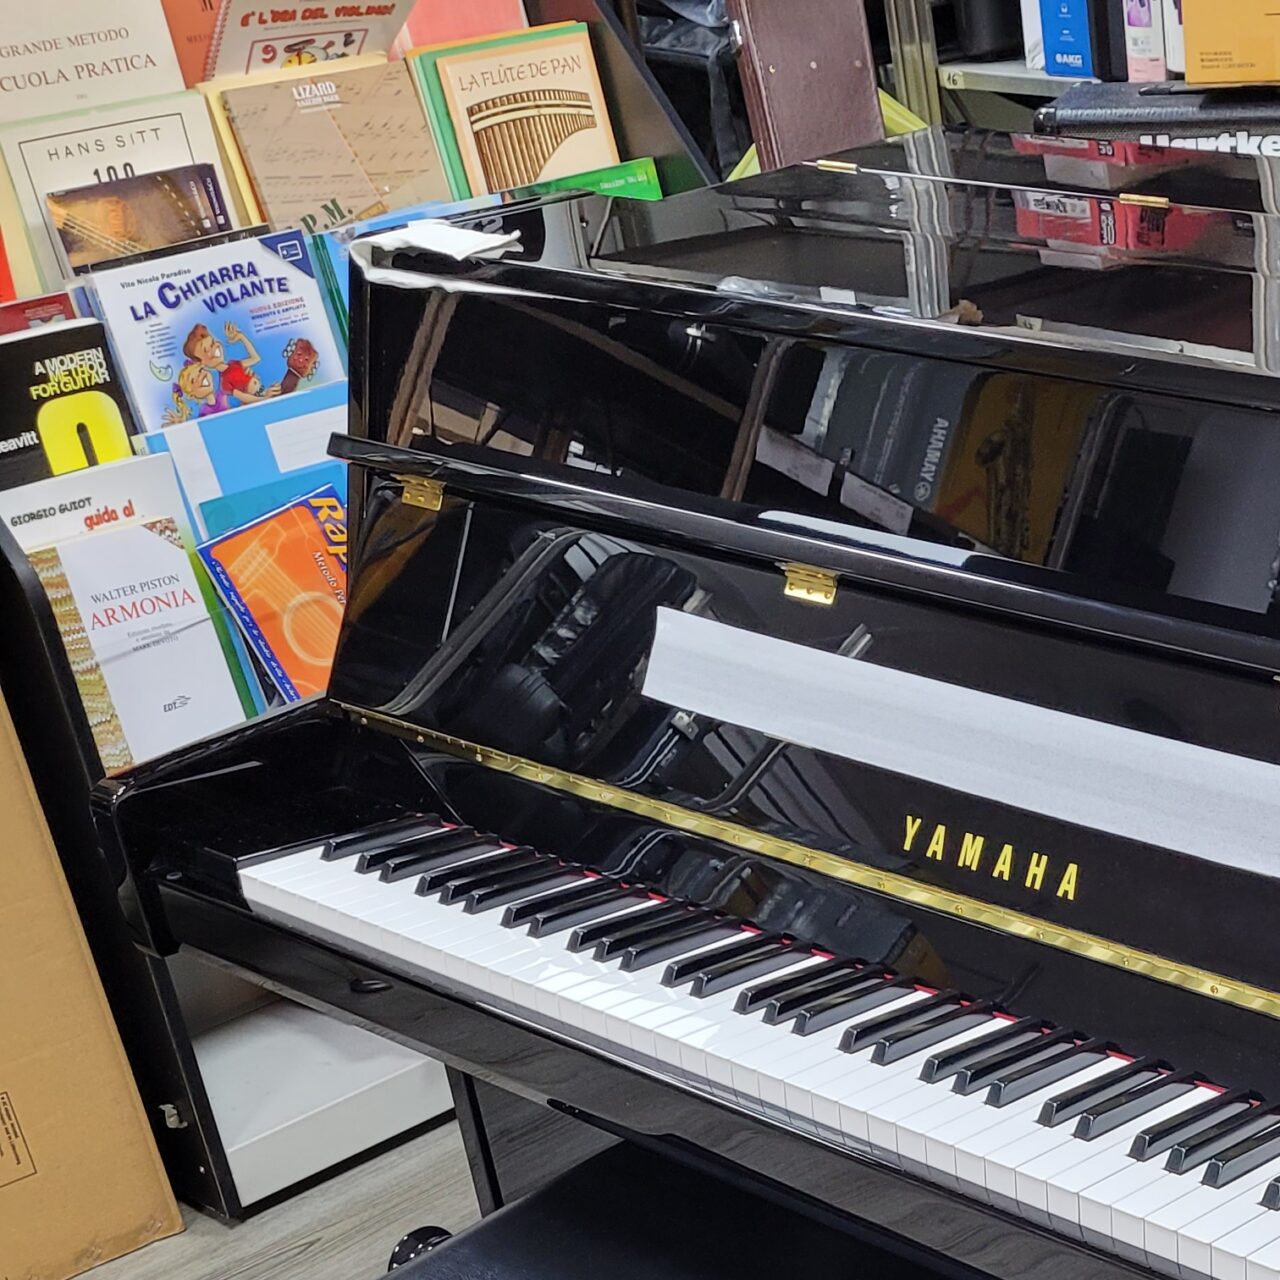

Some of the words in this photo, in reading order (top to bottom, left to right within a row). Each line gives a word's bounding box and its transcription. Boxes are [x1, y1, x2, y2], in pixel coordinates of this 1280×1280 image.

[0, 37, 66, 58] GRANDE
[67, 26, 130, 49] METODO
[74, 53, 157, 80] PRATICA
[458, 74, 481, 93] LA
[527, 62, 551, 78] DE
[552, 55, 582, 75] PAN
[291, 81, 337, 100] LIZARD
[47, 138, 106, 162] HANS
[115, 127, 161, 149] SITT
[130, 300, 157, 322] LA
[157, 261, 259, 309] CHITARRA
[137, 275, 160, 287] Nicola
[161, 267, 192, 281] Paradiso
[202, 276, 289, 314] VOLANTE
[34, 361, 46, 376] A
[44, 347, 105, 371] MODERN
[29, 382, 61, 400] FOR
[60, 369, 111, 392] GUITAR
[10, 504, 57, 527] GIORGIO
[58, 496, 93, 515] GUIOT
[84, 504, 119, 531] guida
[122, 498, 136, 518] al
[312, 550, 337, 589] Metodo
[90, 582, 138, 605] WALTER
[139, 573, 181, 592] PISTON
[90, 587, 197, 631] ARMONIA
[163, 701, 177, 713] EDT
[903, 815, 1078, 901] YAMAHA
